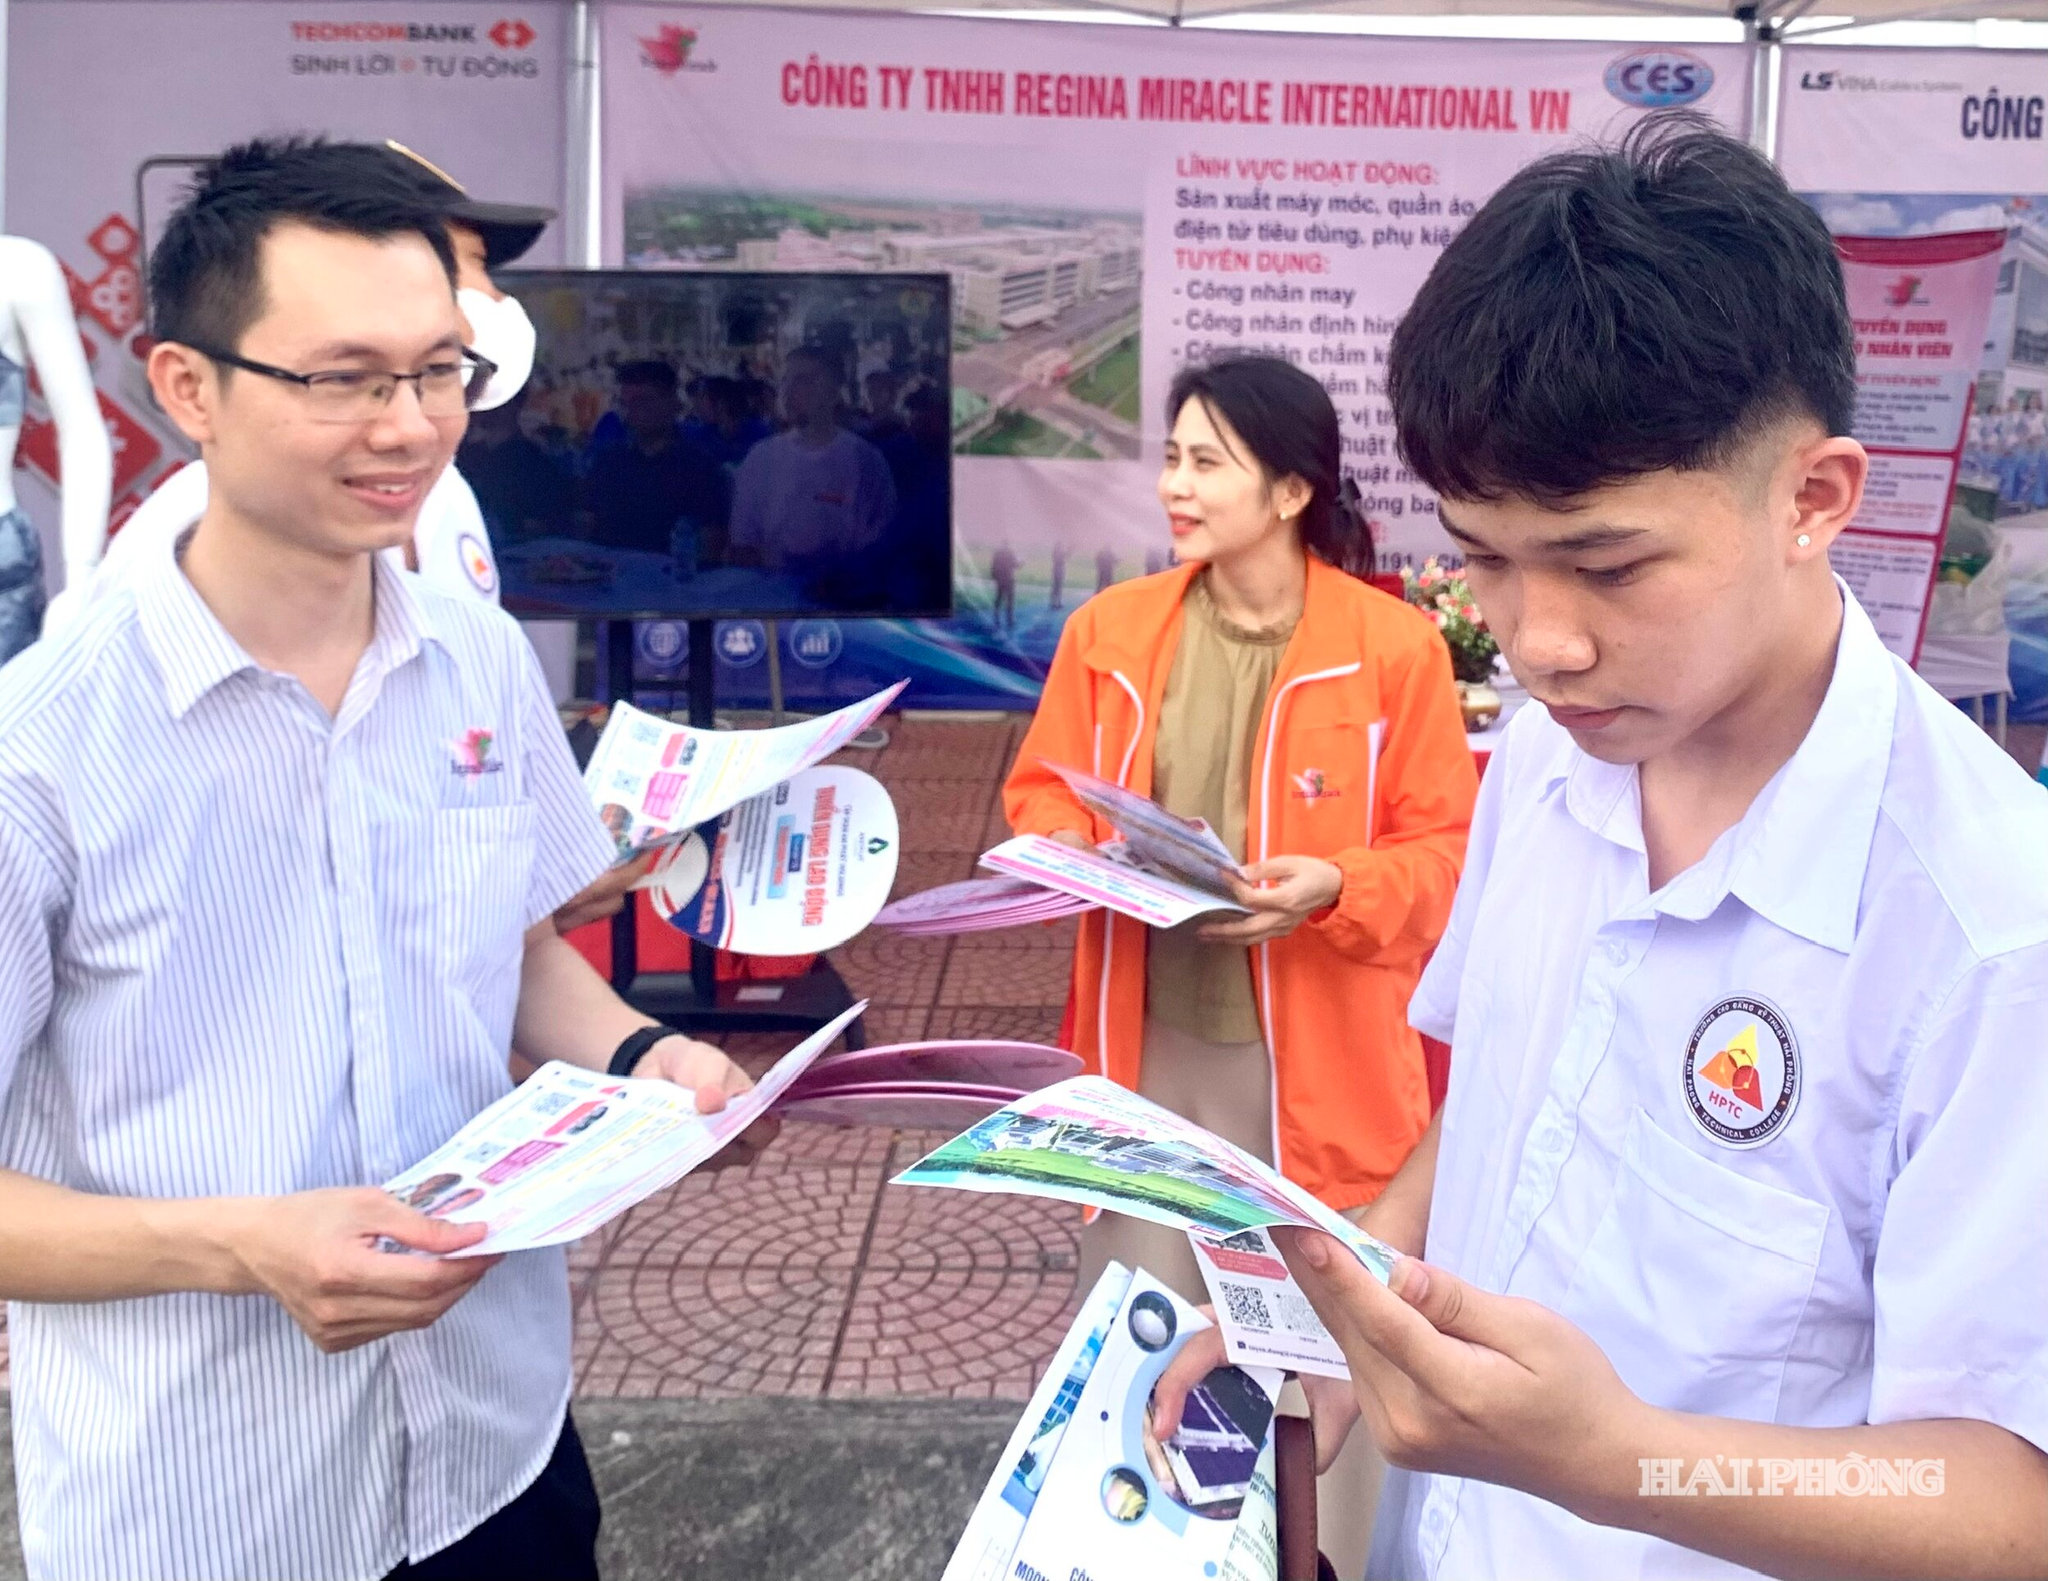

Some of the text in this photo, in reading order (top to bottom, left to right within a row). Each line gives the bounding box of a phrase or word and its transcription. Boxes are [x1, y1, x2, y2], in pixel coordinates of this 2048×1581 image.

[291, 22, 476, 42] TECHCOMBANK
[291, 55, 349, 75] SINH
[1621, 63, 1695, 93] CES
[781, 52, 1572, 133] CÔNG TY TNHH REGINA MIRACLE INTERNATIONAL VN
[1801, 71, 1833, 91] LS
[1961, 86, 2044, 140] CÔNG
[1176, 153, 1230, 179] LĨNH
[1236, 157, 1288, 184] VỰC
[1292, 160, 1358, 187] HOẠT
[1224, 185, 1271, 211] xuất
[1276, 190, 1323, 218] máy
[1387, 189, 1442, 219] quần
[1174, 219, 1222, 243] điện
[1257, 221, 1299, 242] tiêu
[1372, 224, 1413, 250] phụ
[1420, 224, 1452, 249] kiệ
[1173, 247, 1249, 272] TUYỂN
[1186, 279, 1357, 309] Công nhân may
[1185, 309, 1243, 337] Công
[1249, 311, 1303, 333] nhân
[1308, 313, 1356, 338] định
[807, 860, 828, 886] LAO
[1707, 1089, 1744, 1119] HPTC
[1701, 1111, 1745, 1138] TECHNICAL
[1749, 1108, 1783, 1137] COLLEGE
